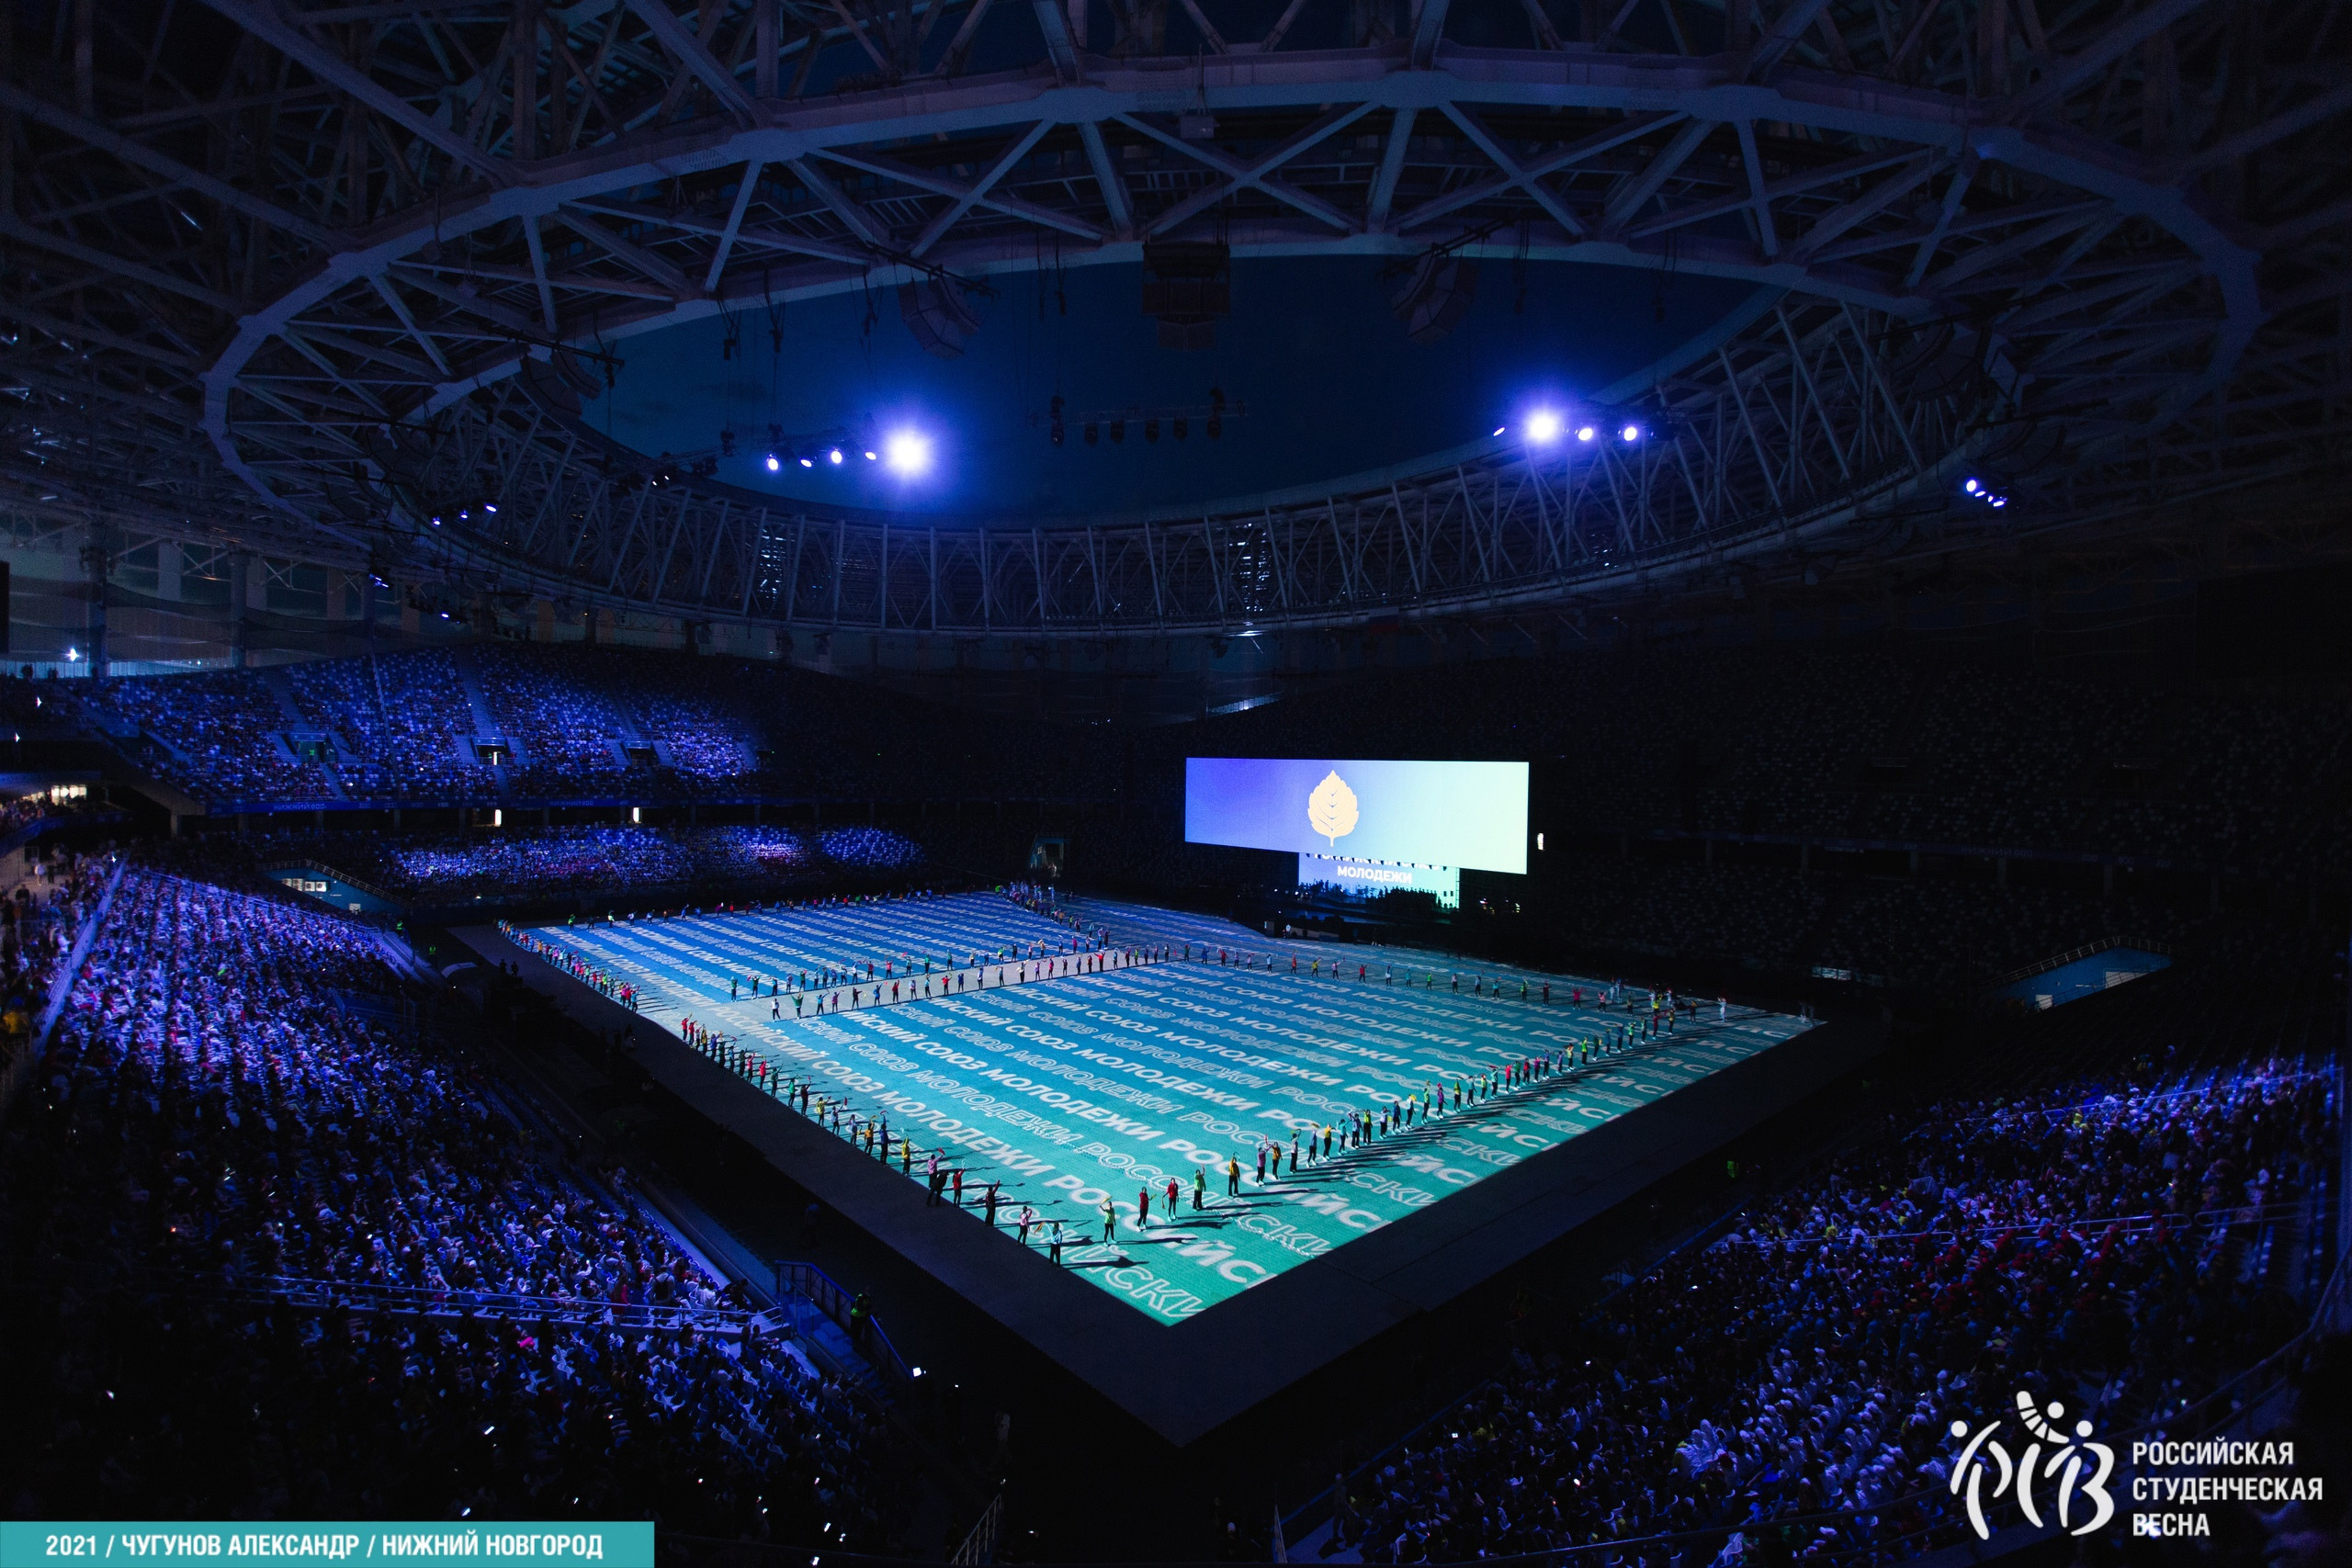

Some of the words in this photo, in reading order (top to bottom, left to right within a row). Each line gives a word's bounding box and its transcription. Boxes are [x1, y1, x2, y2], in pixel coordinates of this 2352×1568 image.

[1337, 864, 1413, 885] МОЛОДЕЖИ
[936, 1025, 1019, 1052] СОЮЗ
[1079, 1010, 1164, 1033] СОЮЗ
[1150, 1031, 1346, 1087] МОЛОДЕЖИ
[1149, 997, 1235, 1018] СОЮЗ
[1224, 1016, 1413, 1066] МОЛОДЕЖИ
[1216, 986, 1298, 1005] СОЮЗ
[1288, 1003, 1474, 1047] МОЛОДЕЖИ
[631, 972, 723, 1008] МОЛОДЕЖИ
[807, 1059, 890, 1093] СОЮЗ
[869, 1090, 1058, 1179] МОЛОДЕЖИ
[842, 1042, 924, 1072] СОЮЗ
[902, 1069, 1085, 1145] МОЛОДЕЖИ
[908, 1041, 992, 1070] СОЮЗ
[975, 1067, 1168, 1143] МОЛОДЕЖИ
[997, 1024, 1085, 1051] СОЮЗ
[1069, 1048, 1263, 1111] МОЛОДЕЖИ
